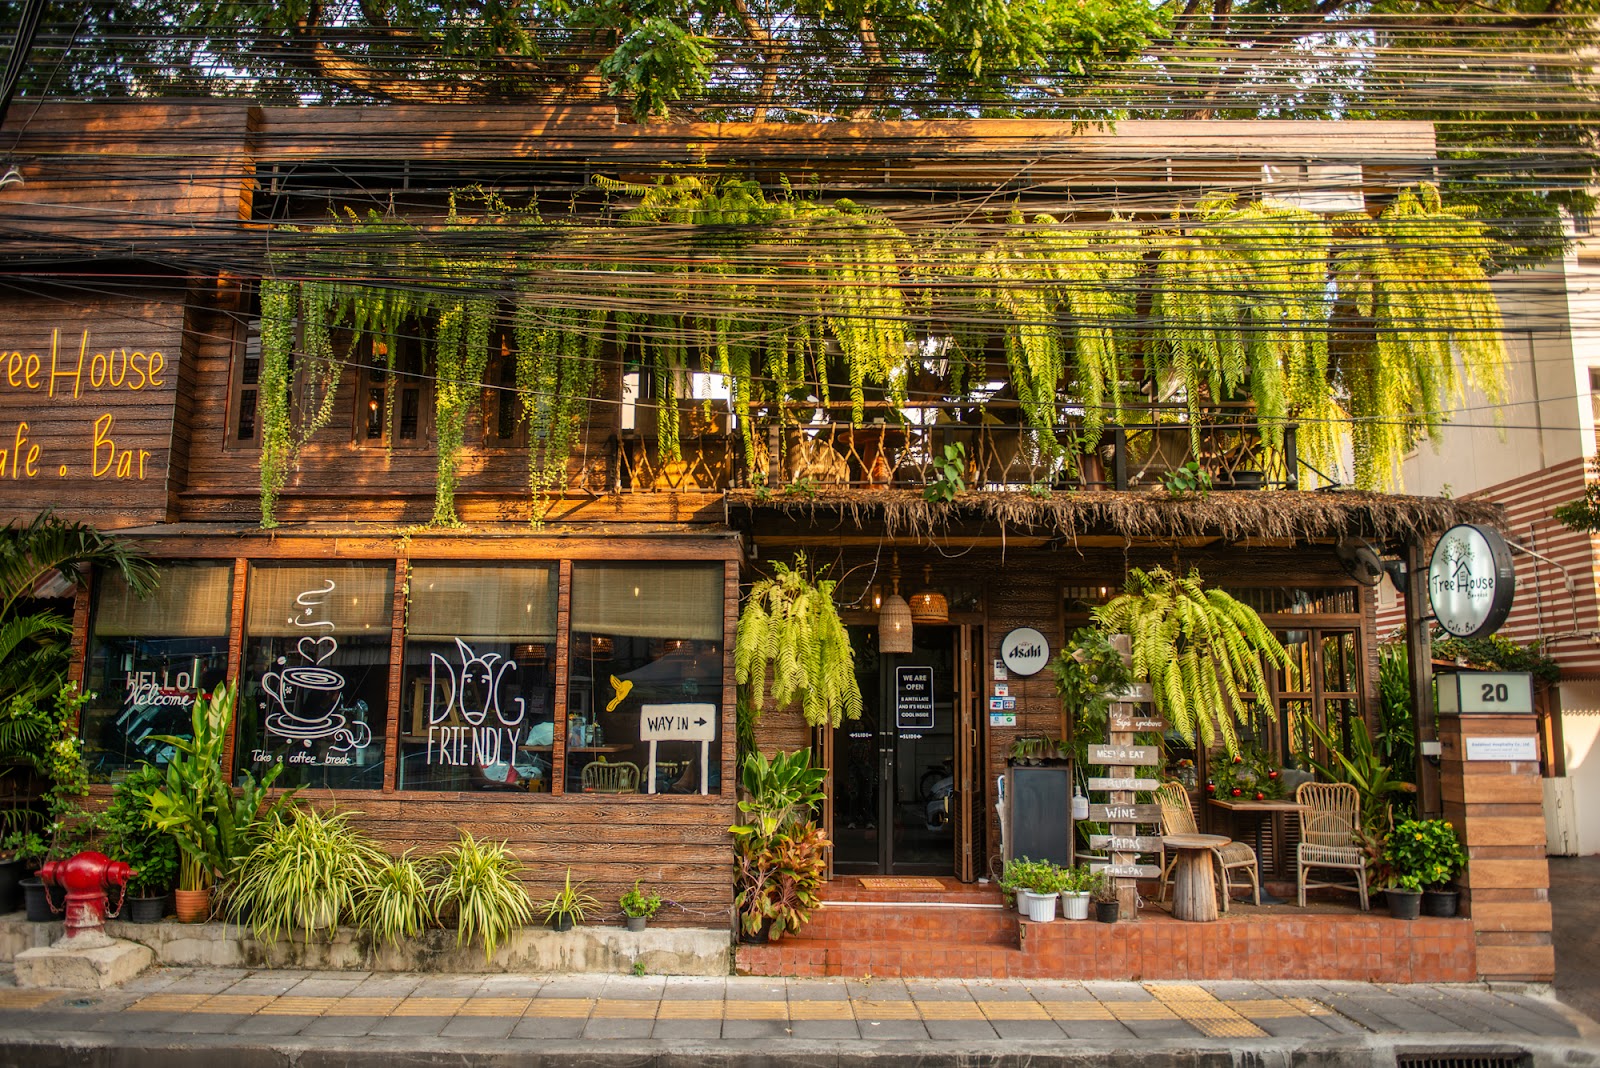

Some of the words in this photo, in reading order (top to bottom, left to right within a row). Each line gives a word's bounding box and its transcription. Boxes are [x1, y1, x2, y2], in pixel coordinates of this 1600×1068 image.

[93, 413, 151, 479] Bar
[1432, 572, 1494, 594] TreeHouse
[1009, 645, 1041, 658] Asahi
[430, 638, 525, 726] DOG
[902, 674, 913, 682] WE
[914, 674, 927, 682] ARE
[124, 681, 195, 706] Welcome
[905, 683, 924, 691] OPEN
[1481, 683, 1509, 702] 20
[647, 716, 674, 732] WAY
[677, 716, 689, 730] IN
[427, 726, 521, 767] FRIENDLY
[1129, 750, 1145, 759] EAT
[251, 749, 272, 762] Take
[289, 750, 317, 764] coffee
[325, 752, 351, 764] break
[1107, 836, 1141, 850] TAPAS
